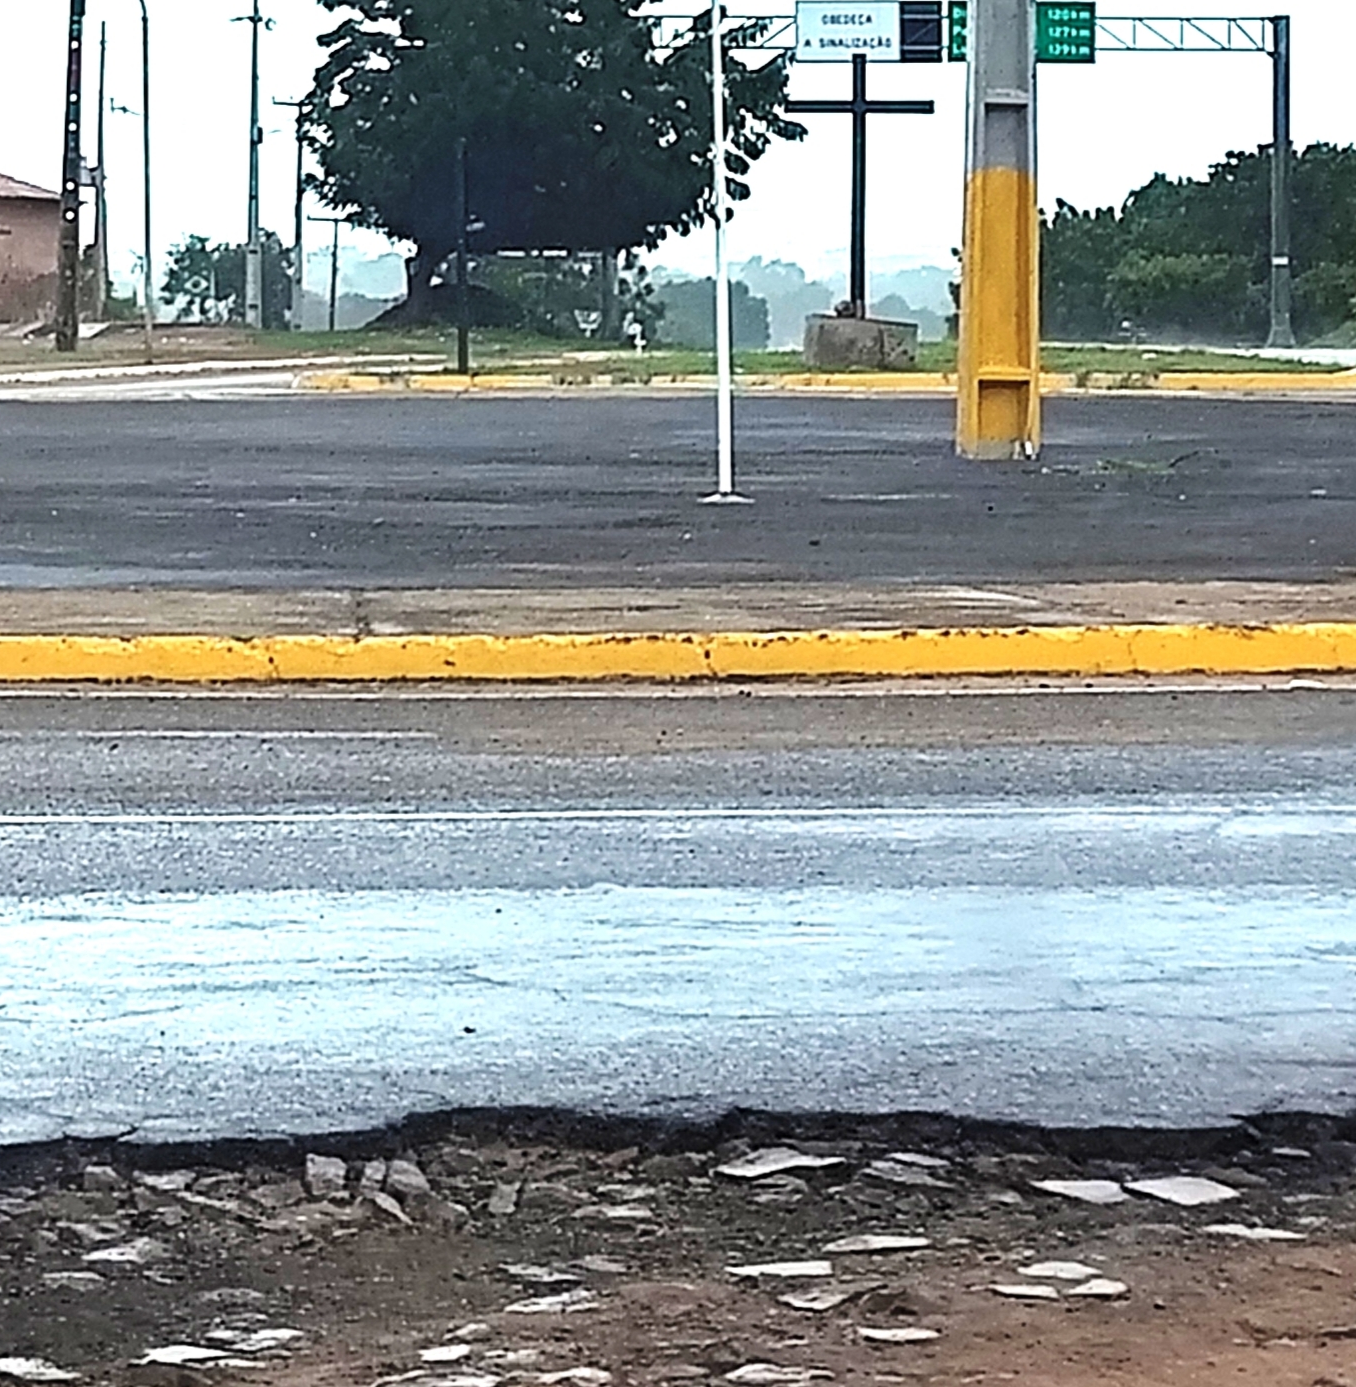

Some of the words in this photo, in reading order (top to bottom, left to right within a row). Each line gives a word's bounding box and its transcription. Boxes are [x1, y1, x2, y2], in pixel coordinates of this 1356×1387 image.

[821, 14, 873, 26] OBEDEÇA
[803, 38, 812, 48] A
[819, 35, 892, 49] SINALIZAÇÃO
